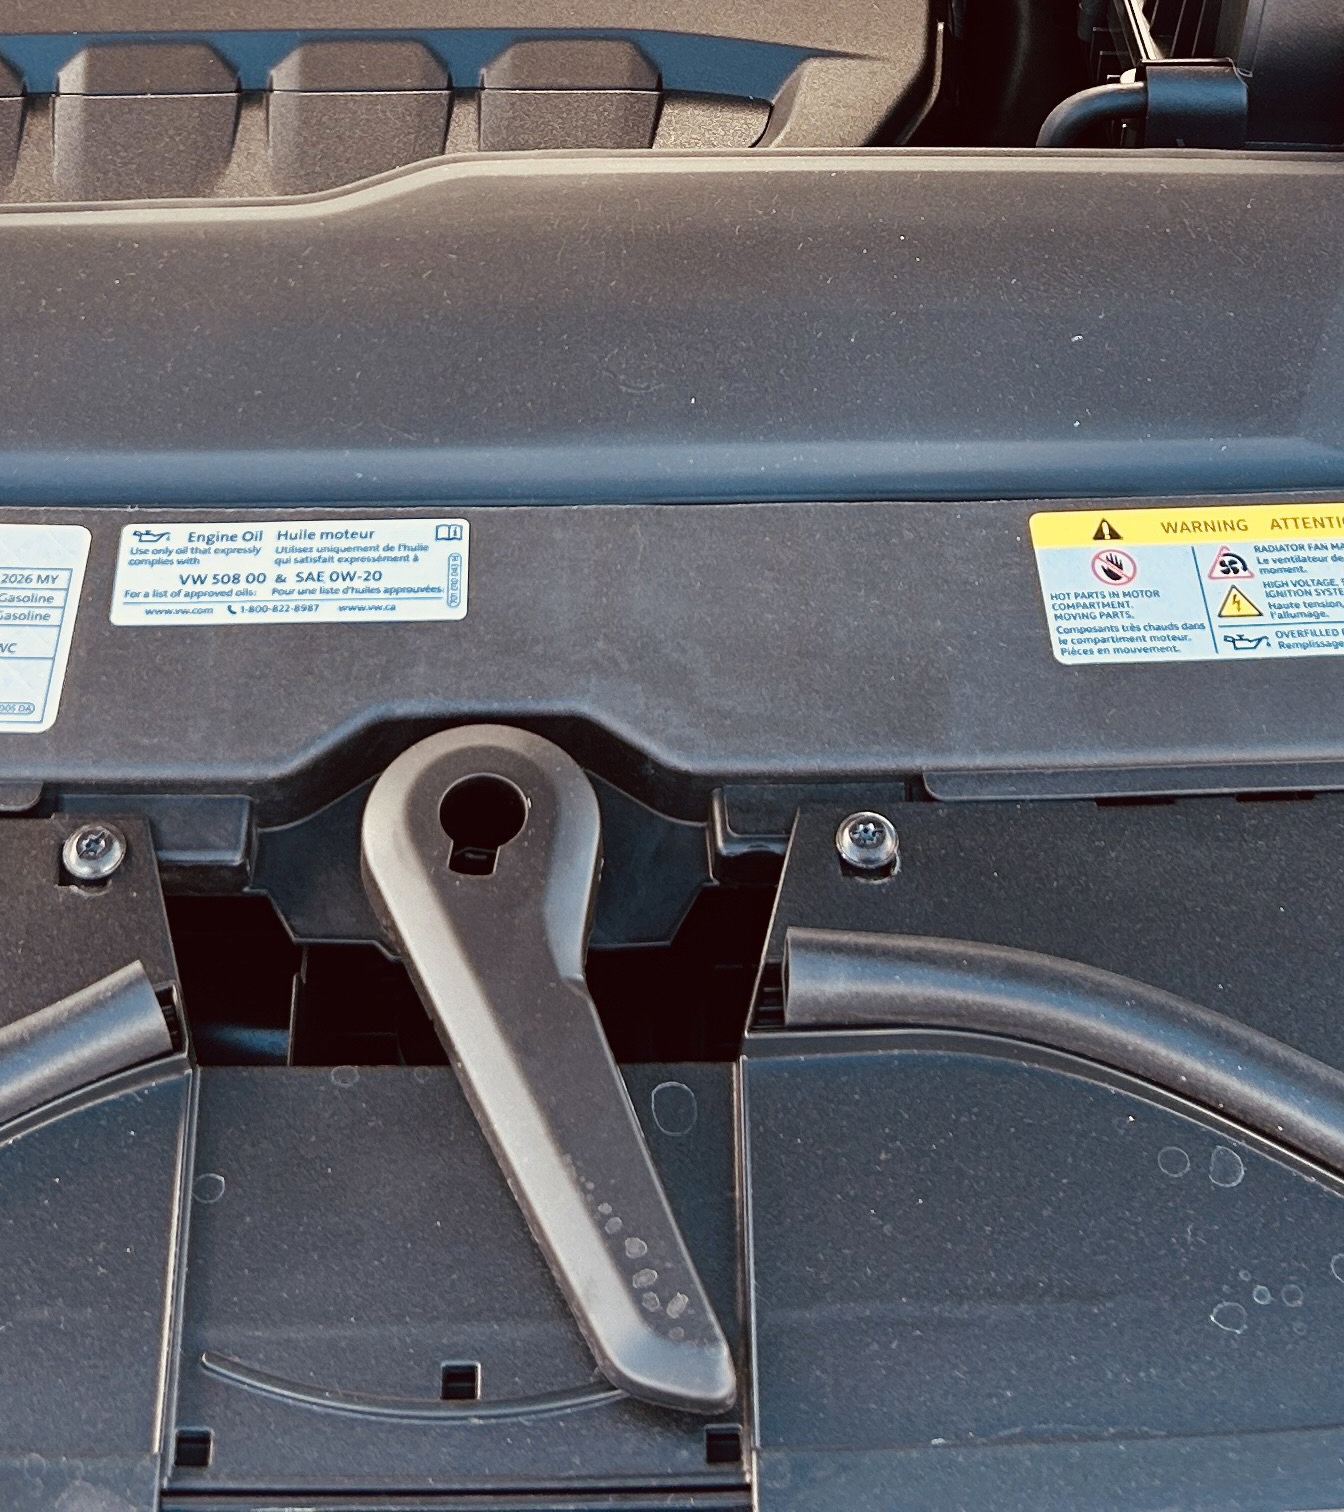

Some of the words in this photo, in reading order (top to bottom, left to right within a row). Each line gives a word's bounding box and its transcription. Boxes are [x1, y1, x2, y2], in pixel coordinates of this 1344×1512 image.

[1161, 519, 1248, 534] WARNING
[188, 532, 238, 545] Engine
[242, 531, 263, 542] Oil
[277, 529, 316, 540] Huile
[320, 529, 375, 540] moteur
[130, 547, 150, 555] Use
[151, 547, 174, 557] only
[175, 546, 188, 554] oil
[214, 545, 261, 556] expressly
[275, 545, 313, 554] Utilisez
[316, 544, 379, 554] uniquement
[382, 544, 395, 552] de
[1254, 544, 1306, 553] RADIATOR
[1308, 543, 1328, 551] FAN
[128, 557, 174, 568] complies
[176, 557, 200, 565] with
[274, 558, 291, 566] qui
[294, 555, 334, 564] satisfait
[1271, 555, 1328, 564] ventilateur
[1331, 554, 1344, 562] de
[1259, 566, 1307, 574] moment.
[1, 574, 33, 584] 2026
[37, 574, 59, 584] MY
[180, 574, 208, 585] VW
[212, 573, 240, 584] 508
[246, 573, 266, 584] 00
[275, 574, 287, 583] &
[296, 571, 324, 583] SAE
[330, 571, 382, 582] 0W-20
[124, 590, 141, 598] For
[152, 590, 168, 598] list
[170, 589, 181, 598] of
[184, 589, 233, 599] approved
[272, 588, 295, 596] Pour
[319, 586, 340, 594] liste
[342, 586, 381, 594] d'huiles
[1050, 593, 1071, 601] HOT
[1074, 591, 1106, 600] PARTS
[1122, 590, 1160, 598] MOTOR
[1265, 589, 1312, 598] IGNITION
[241, 604, 319, 613] 1-800-822-8987
[1052, 601, 1134, 611] COMPARTMENT.
[1268, 602, 1300, 610] Haute
[1054, 612, 1097, 621] MOVING
[1099, 611, 1134, 619] PARTS.
[1056, 625, 1120, 634] Composants
[1122, 624, 1141, 632] très
[1143, 622, 1179, 631] chauds
[1275, 629, 1339, 639] OVERFILLED
[1058, 637, 1068, 645] le
[1071, 635, 1147, 645] compartiment
[1278, 640, 1344, 650] Remplissage
[1060, 647, 1094, 656] Pièces
[1113, 645, 1180, 654] mouvement.
